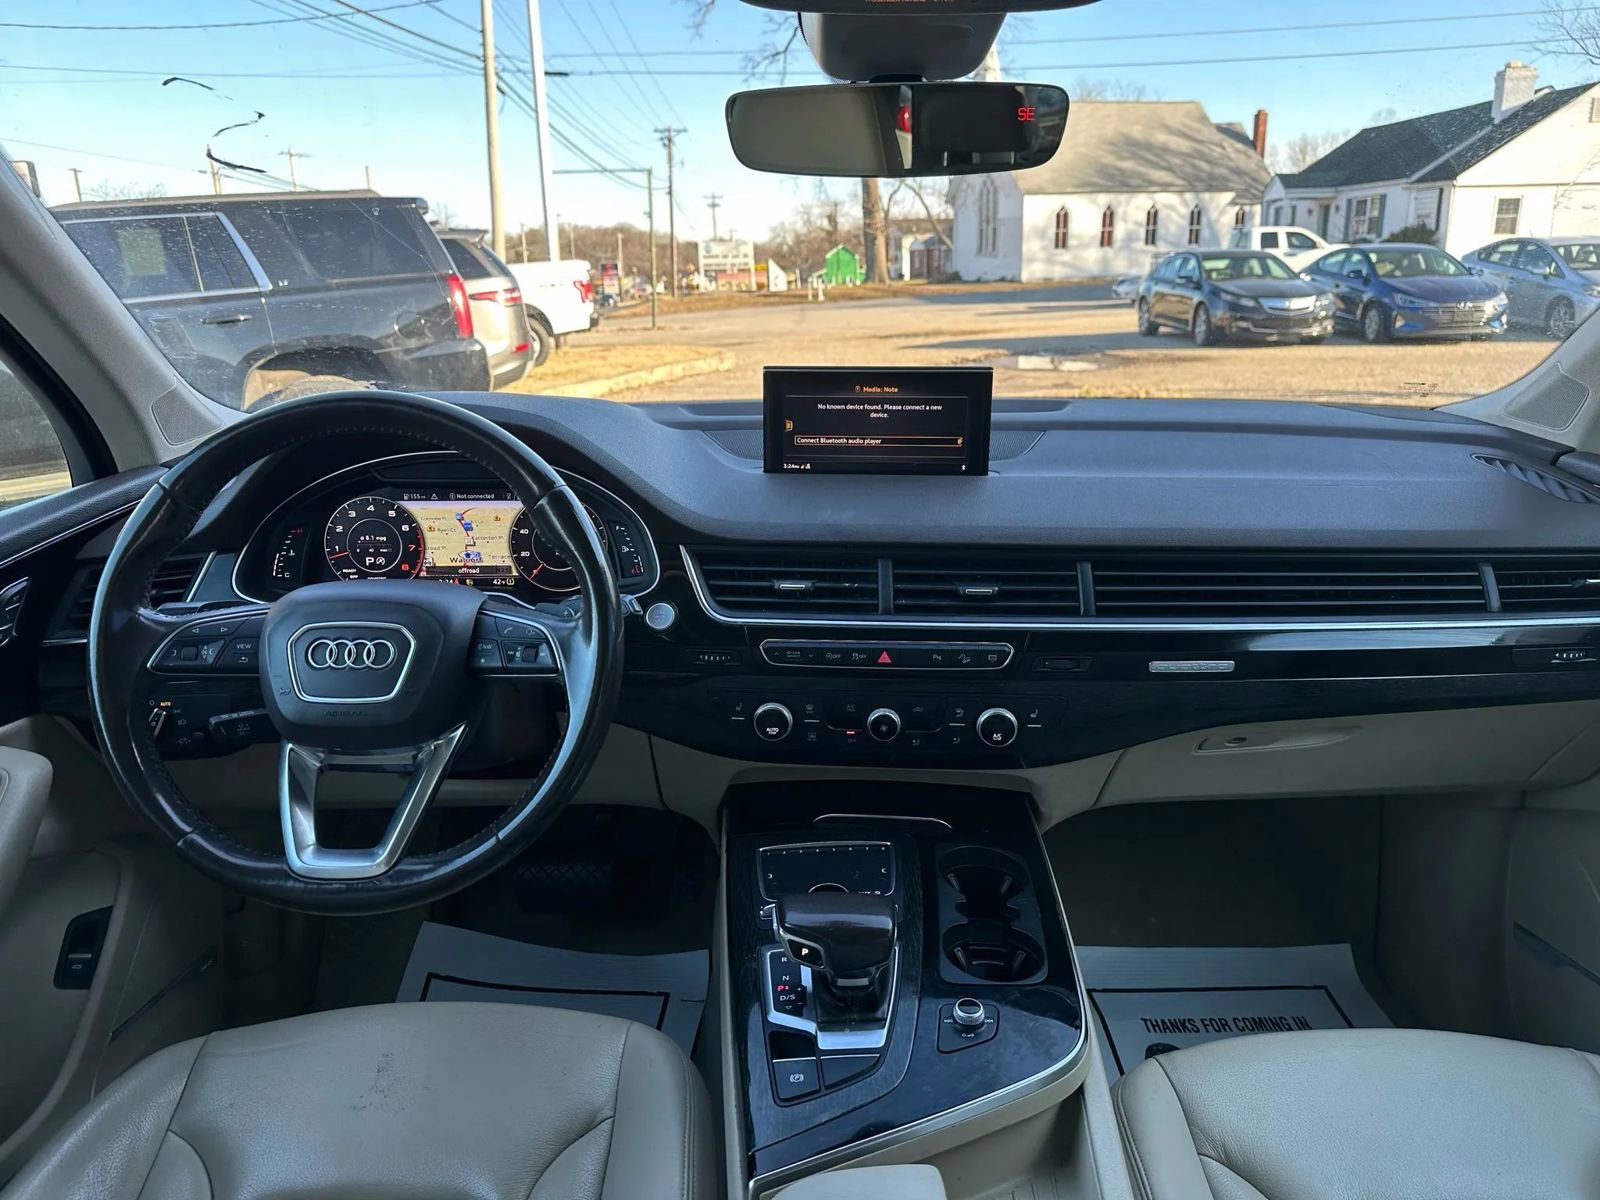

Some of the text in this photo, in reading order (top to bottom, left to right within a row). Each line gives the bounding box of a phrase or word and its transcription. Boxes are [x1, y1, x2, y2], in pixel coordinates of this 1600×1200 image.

[1017, 107, 1036, 121] SE
[864, 438, 882, 446] player
[365, 556, 375, 567] P
[801, 947, 809, 956] P
[1141, 1015, 1313, 1034] THANKS FOR COMING IN
